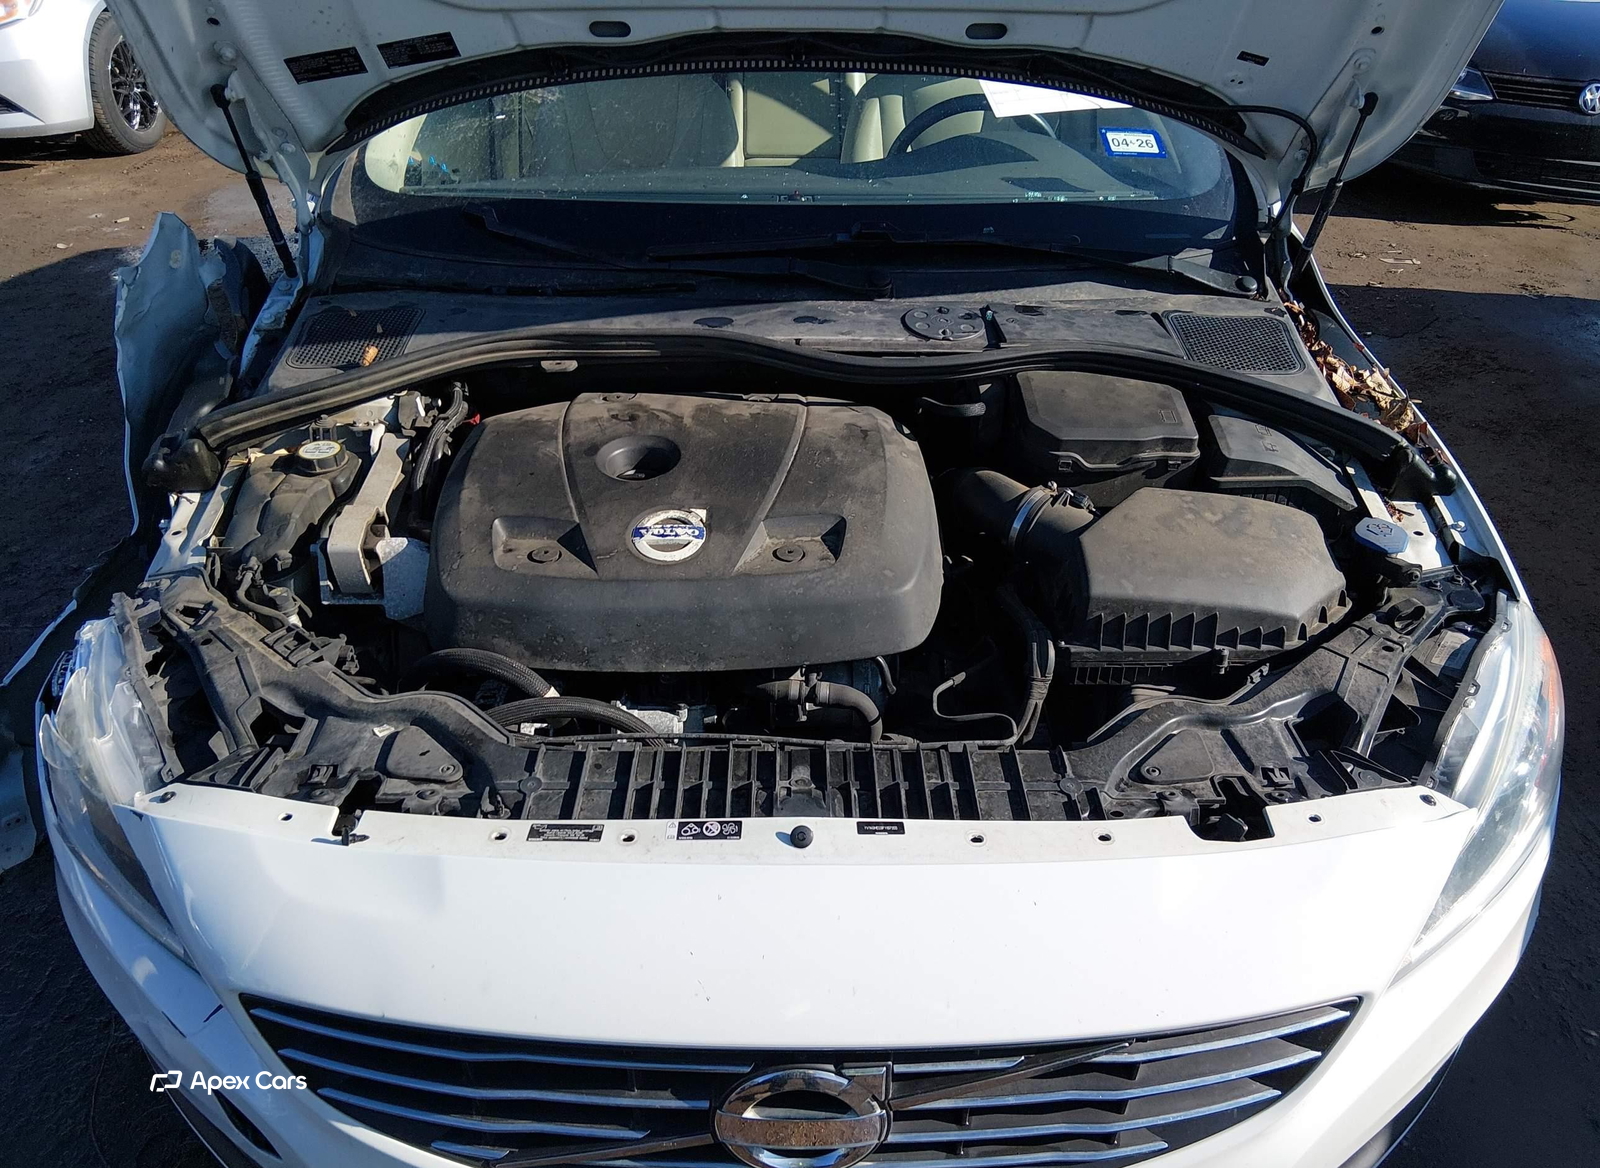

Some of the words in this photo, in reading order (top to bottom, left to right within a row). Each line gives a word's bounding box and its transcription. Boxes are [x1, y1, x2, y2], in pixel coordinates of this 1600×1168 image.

[1111, 137, 1130, 147] 04
[1136, 138, 1154, 149] 26
[637, 527, 700, 537] VOLVO
